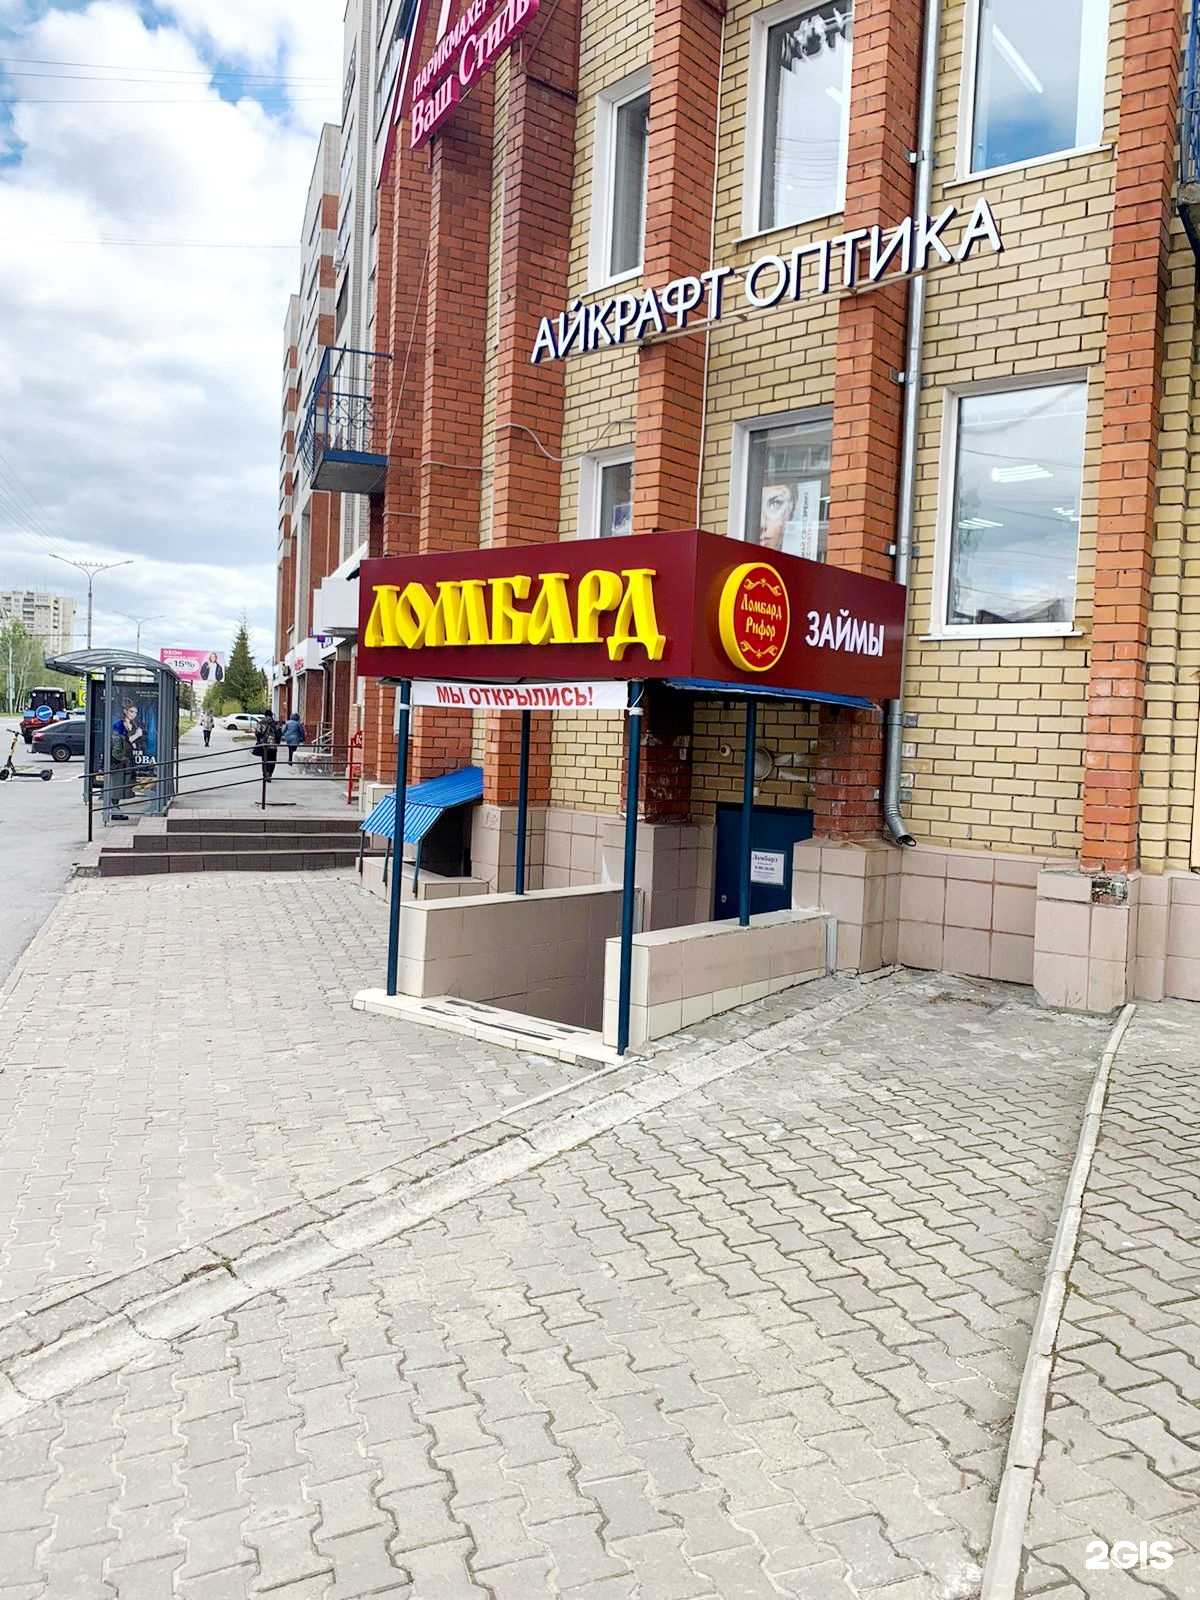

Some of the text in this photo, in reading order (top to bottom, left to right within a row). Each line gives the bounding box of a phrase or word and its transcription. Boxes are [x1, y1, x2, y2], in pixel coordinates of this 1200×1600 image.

[409, 0, 531, 149] Ваш Стиль
[530, 197, 1004, 364] АЙКРАФТ ОПТИКА
[364, 567, 667, 662] ЛОМБАРД
[740, 593, 783, 620] Ломбард
[745, 616, 776, 641] Рифор
[805, 608, 885, 657] ЗАЙМЫ
[435, 685, 594, 707] МЫ ОТКРЫЛИСЬ!
